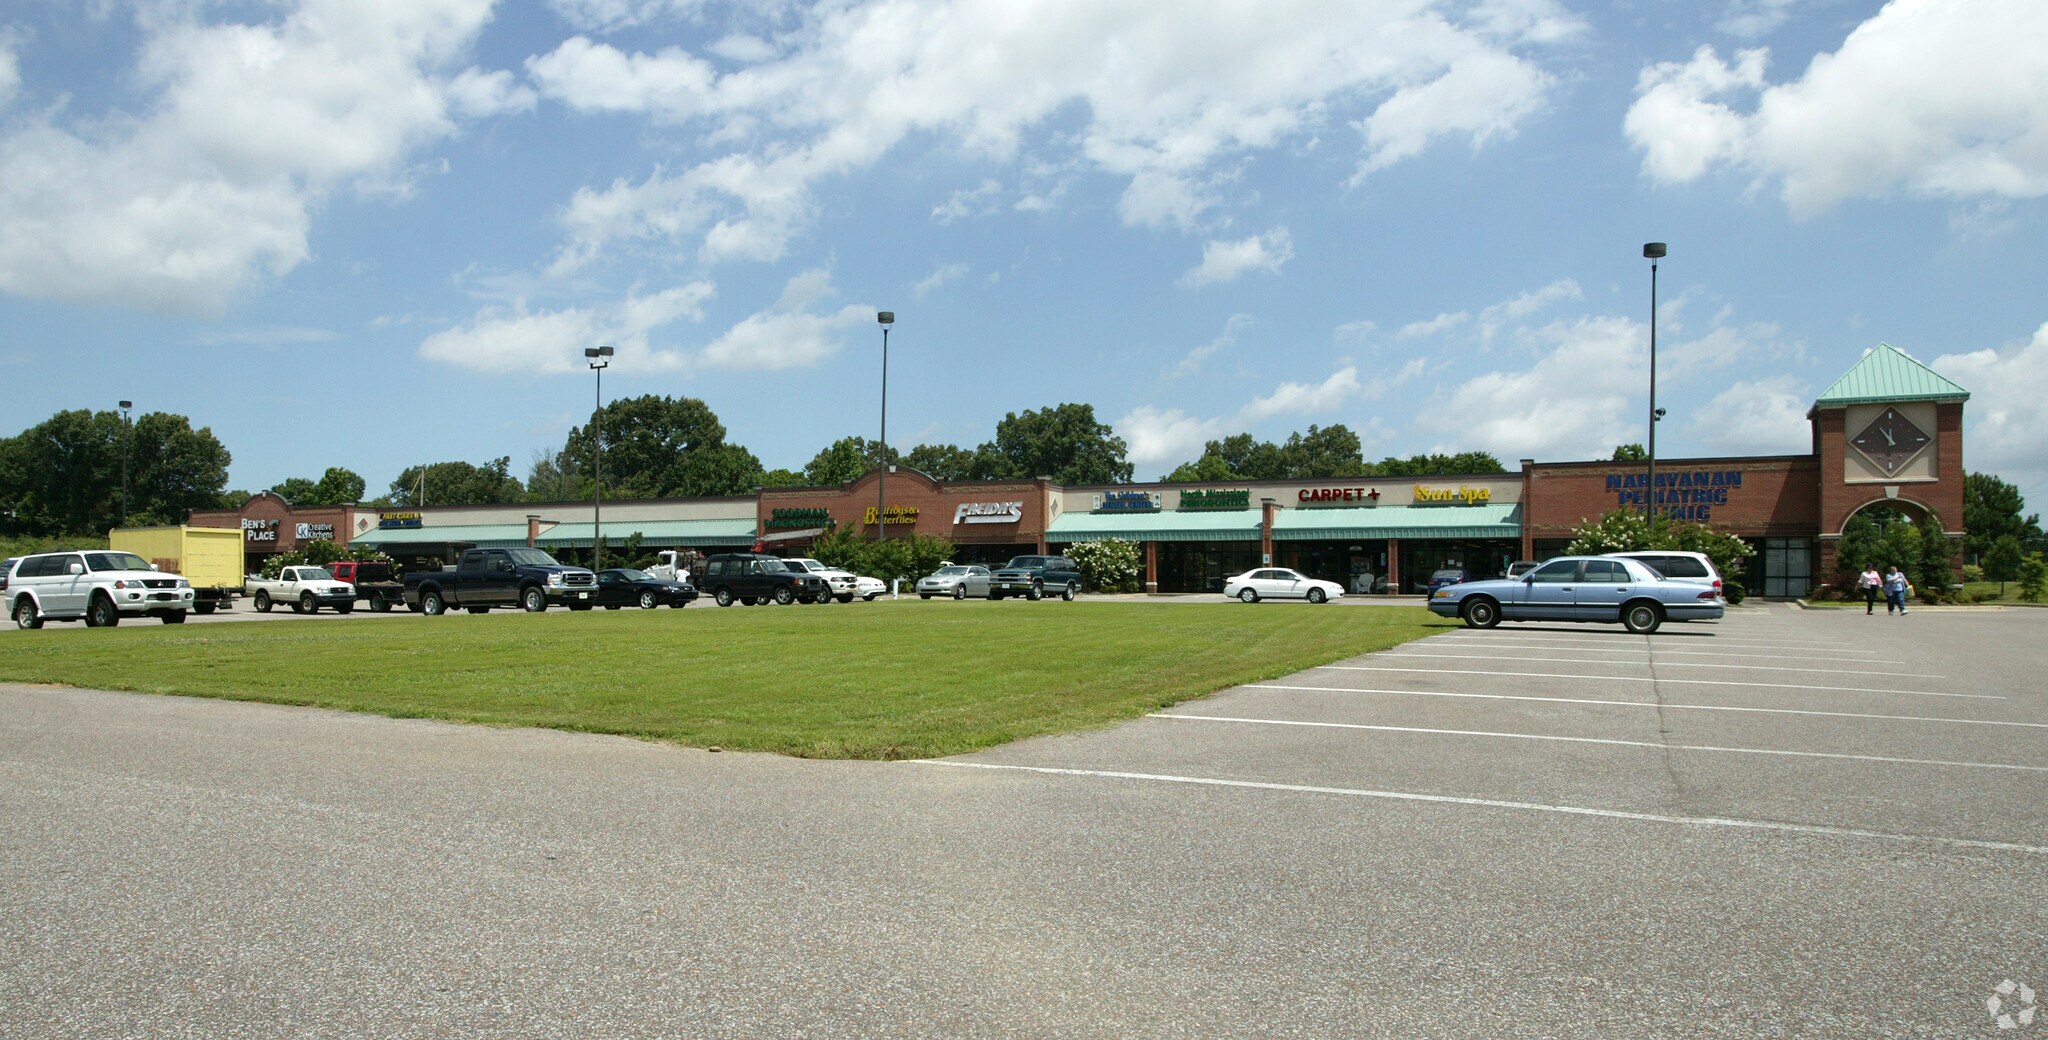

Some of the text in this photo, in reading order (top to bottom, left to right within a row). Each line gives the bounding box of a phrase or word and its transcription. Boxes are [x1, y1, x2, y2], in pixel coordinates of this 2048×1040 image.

[1606, 471, 1742, 489] NARAYANAN
[1180, 490, 1203, 499] North
[1298, 488, 1365, 502] CARPET
[1420, 485, 1489, 505] Sun Spa
[1618, 489, 1728, 505] PEDIATRIC
[772, 508, 829, 517] GOODMAN
[1637, 505, 1711, 521] NIC
[241, 518, 266, 529] BEN'S
[308, 523, 333, 531] Creative
[248, 531, 275, 540] PLACE
[308, 531, 333, 539] Kitchens
